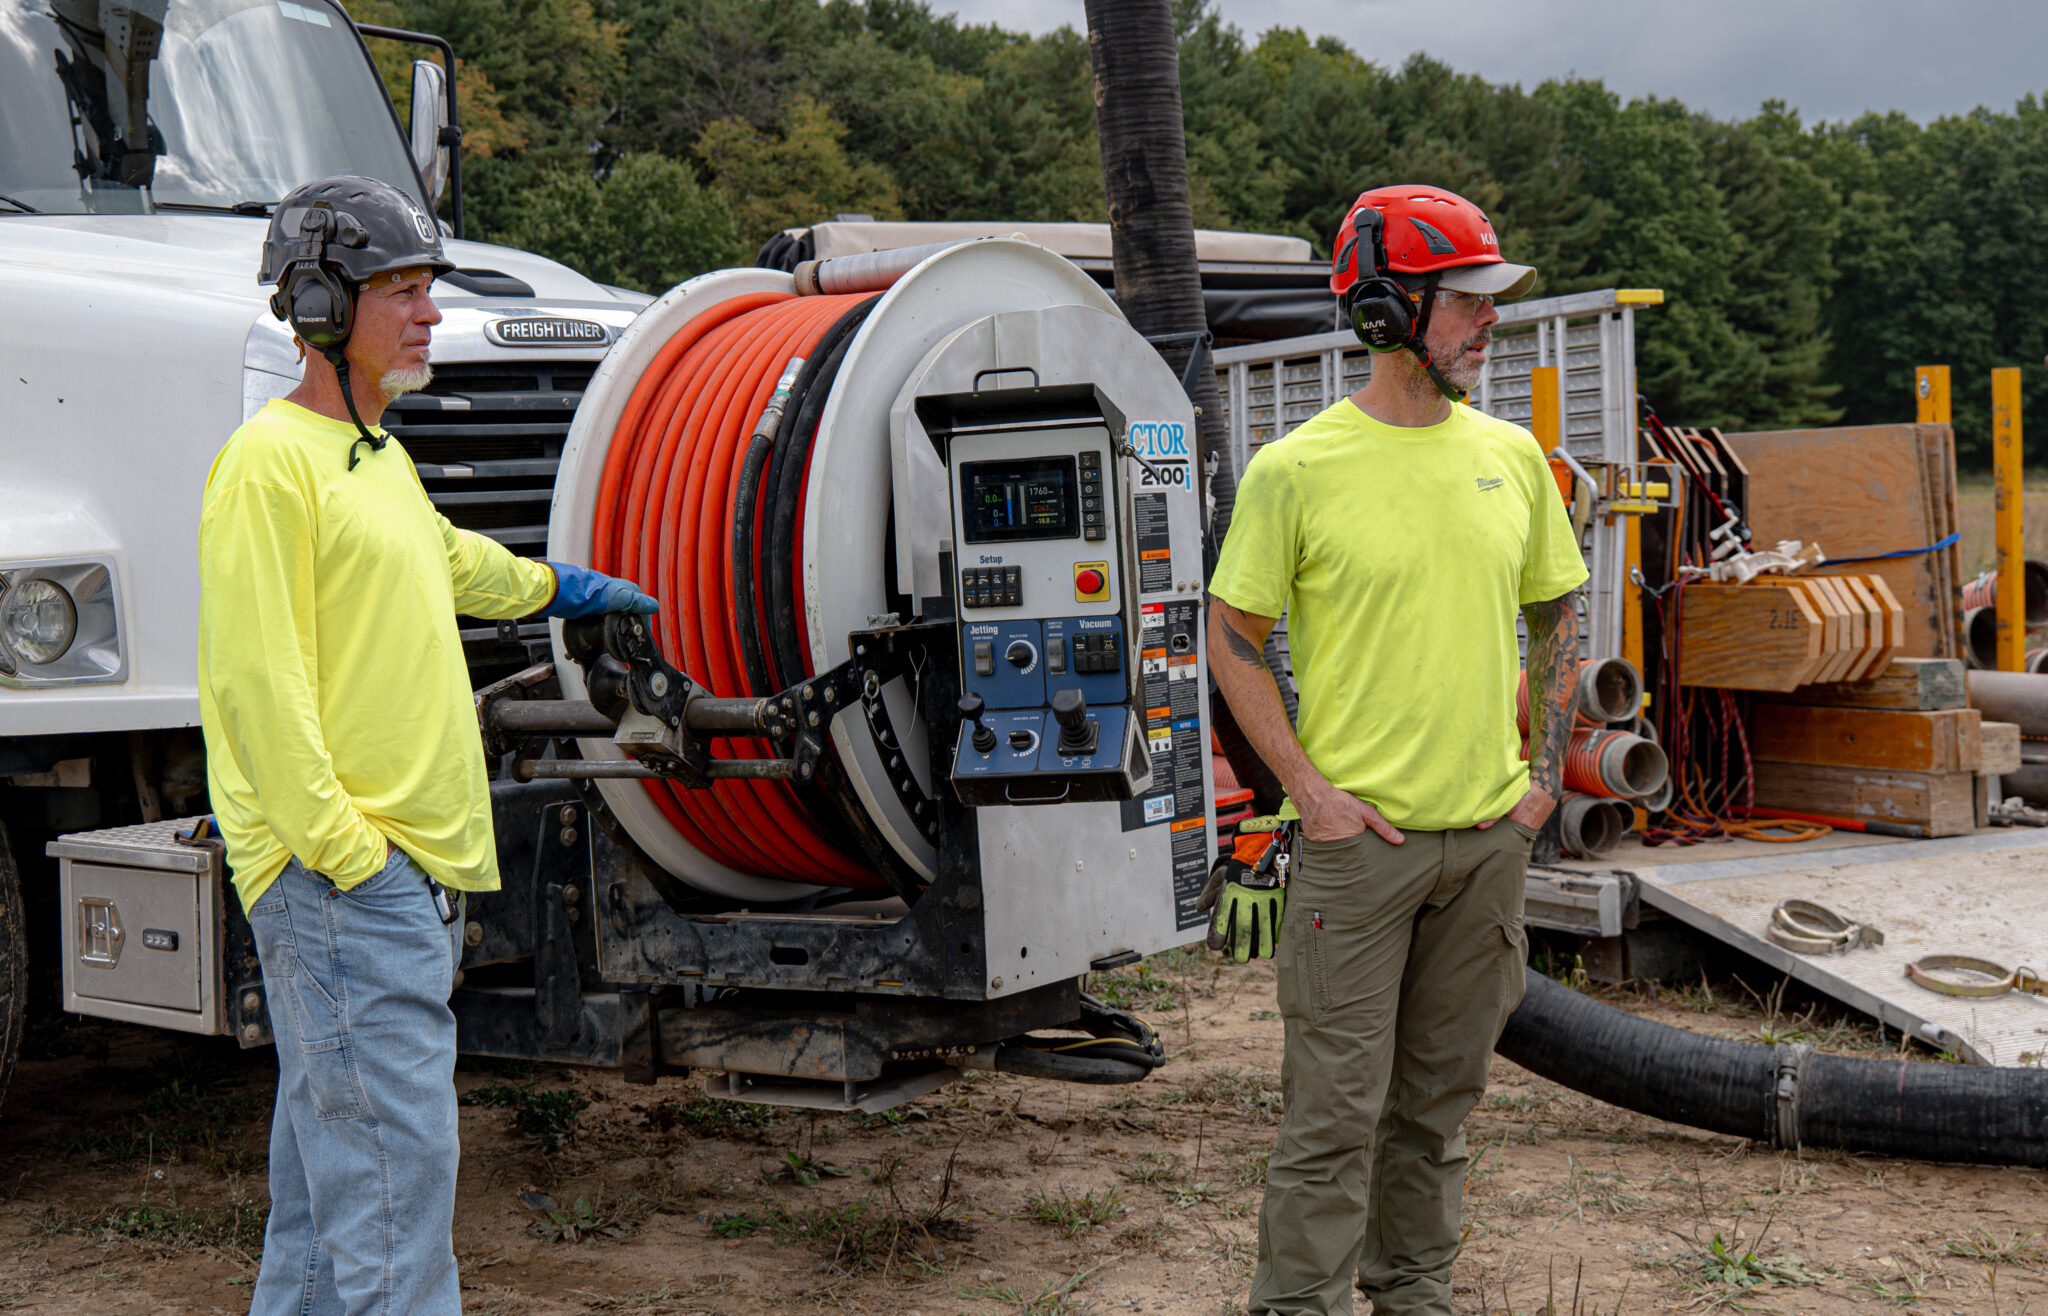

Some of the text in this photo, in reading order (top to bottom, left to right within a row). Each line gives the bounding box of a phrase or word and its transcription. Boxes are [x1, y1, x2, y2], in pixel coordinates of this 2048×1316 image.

[503, 322, 601, 338] FREIGHTLINER
[1029, 487, 1048, 496] 1760
[979, 555, 1003, 564] Setup
[1769, 609, 1799, 629] 2.1E
[1079, 620, 1112, 629] Vacuum
[970, 625, 998, 635] Jetting
